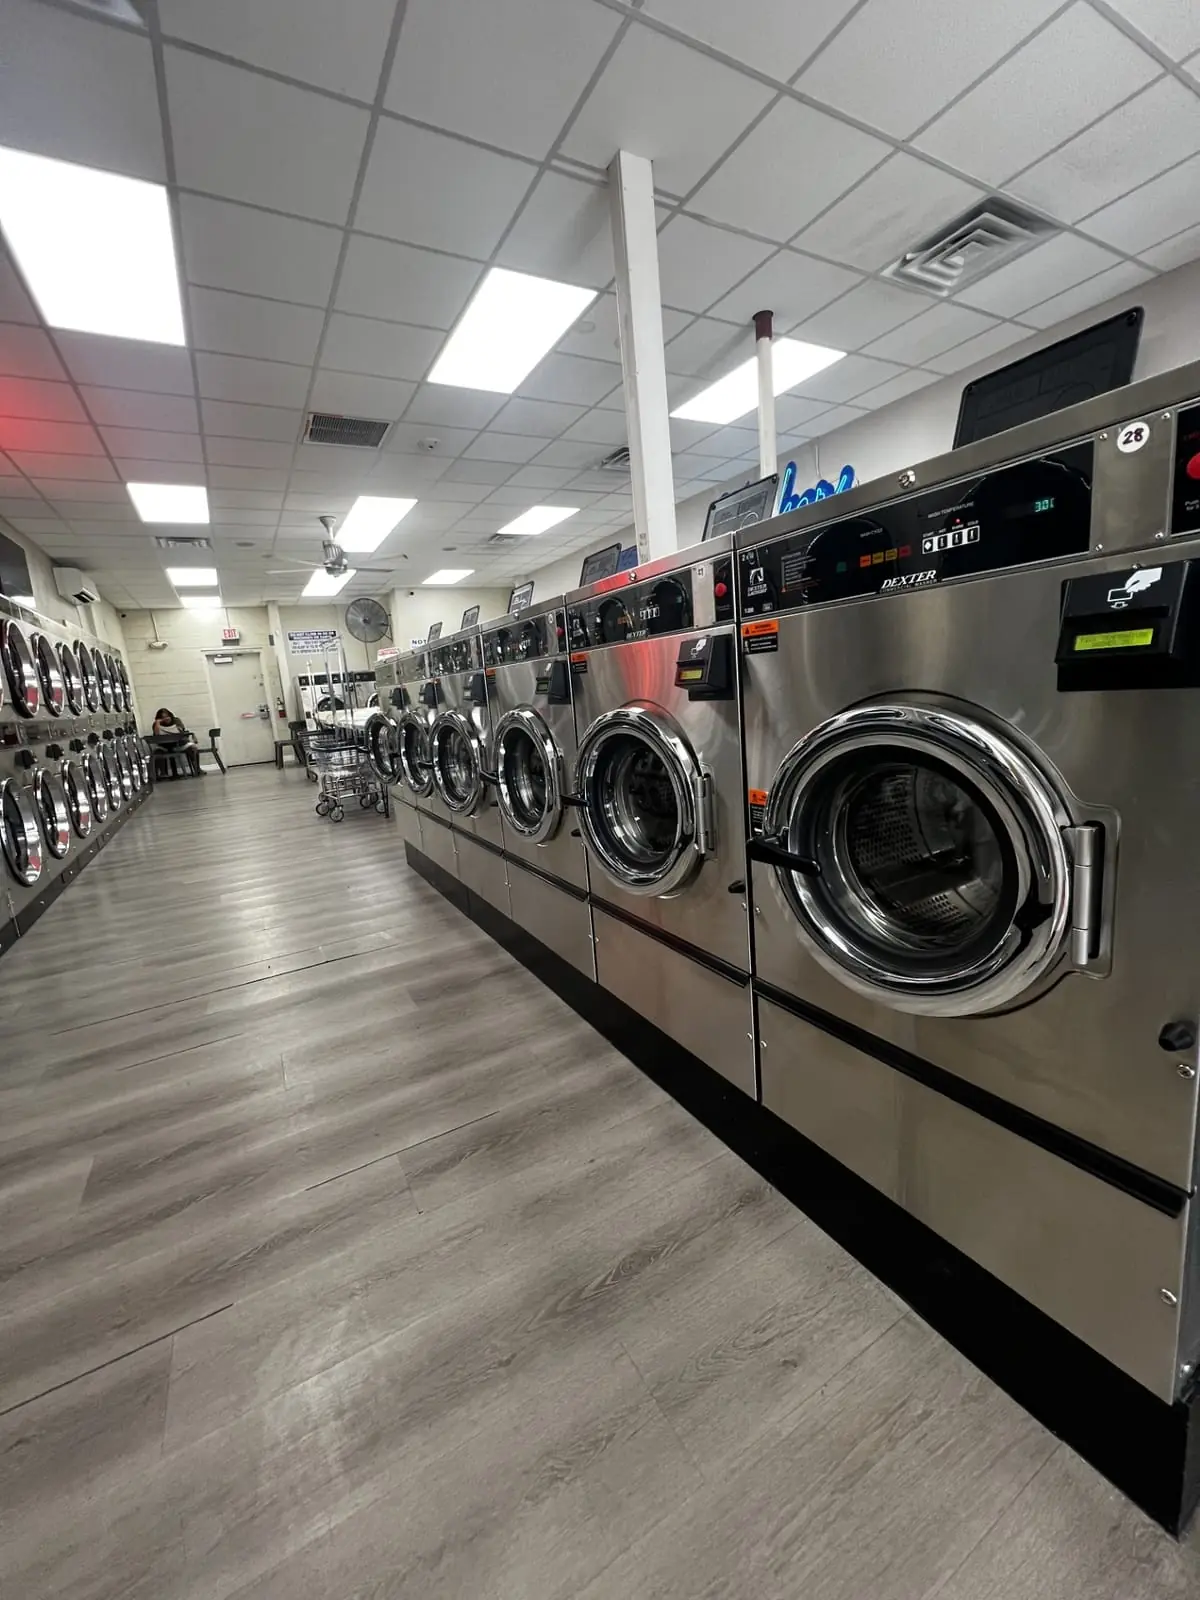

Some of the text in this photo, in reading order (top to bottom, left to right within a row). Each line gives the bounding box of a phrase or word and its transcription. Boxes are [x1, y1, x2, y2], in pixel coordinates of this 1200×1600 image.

[1122, 428, 1144, 445] 28
[941, 501, 975, 515] TEMPERATURE
[881, 570, 937, 588] DEXTER
[223, 628, 237, 639] EXIT
